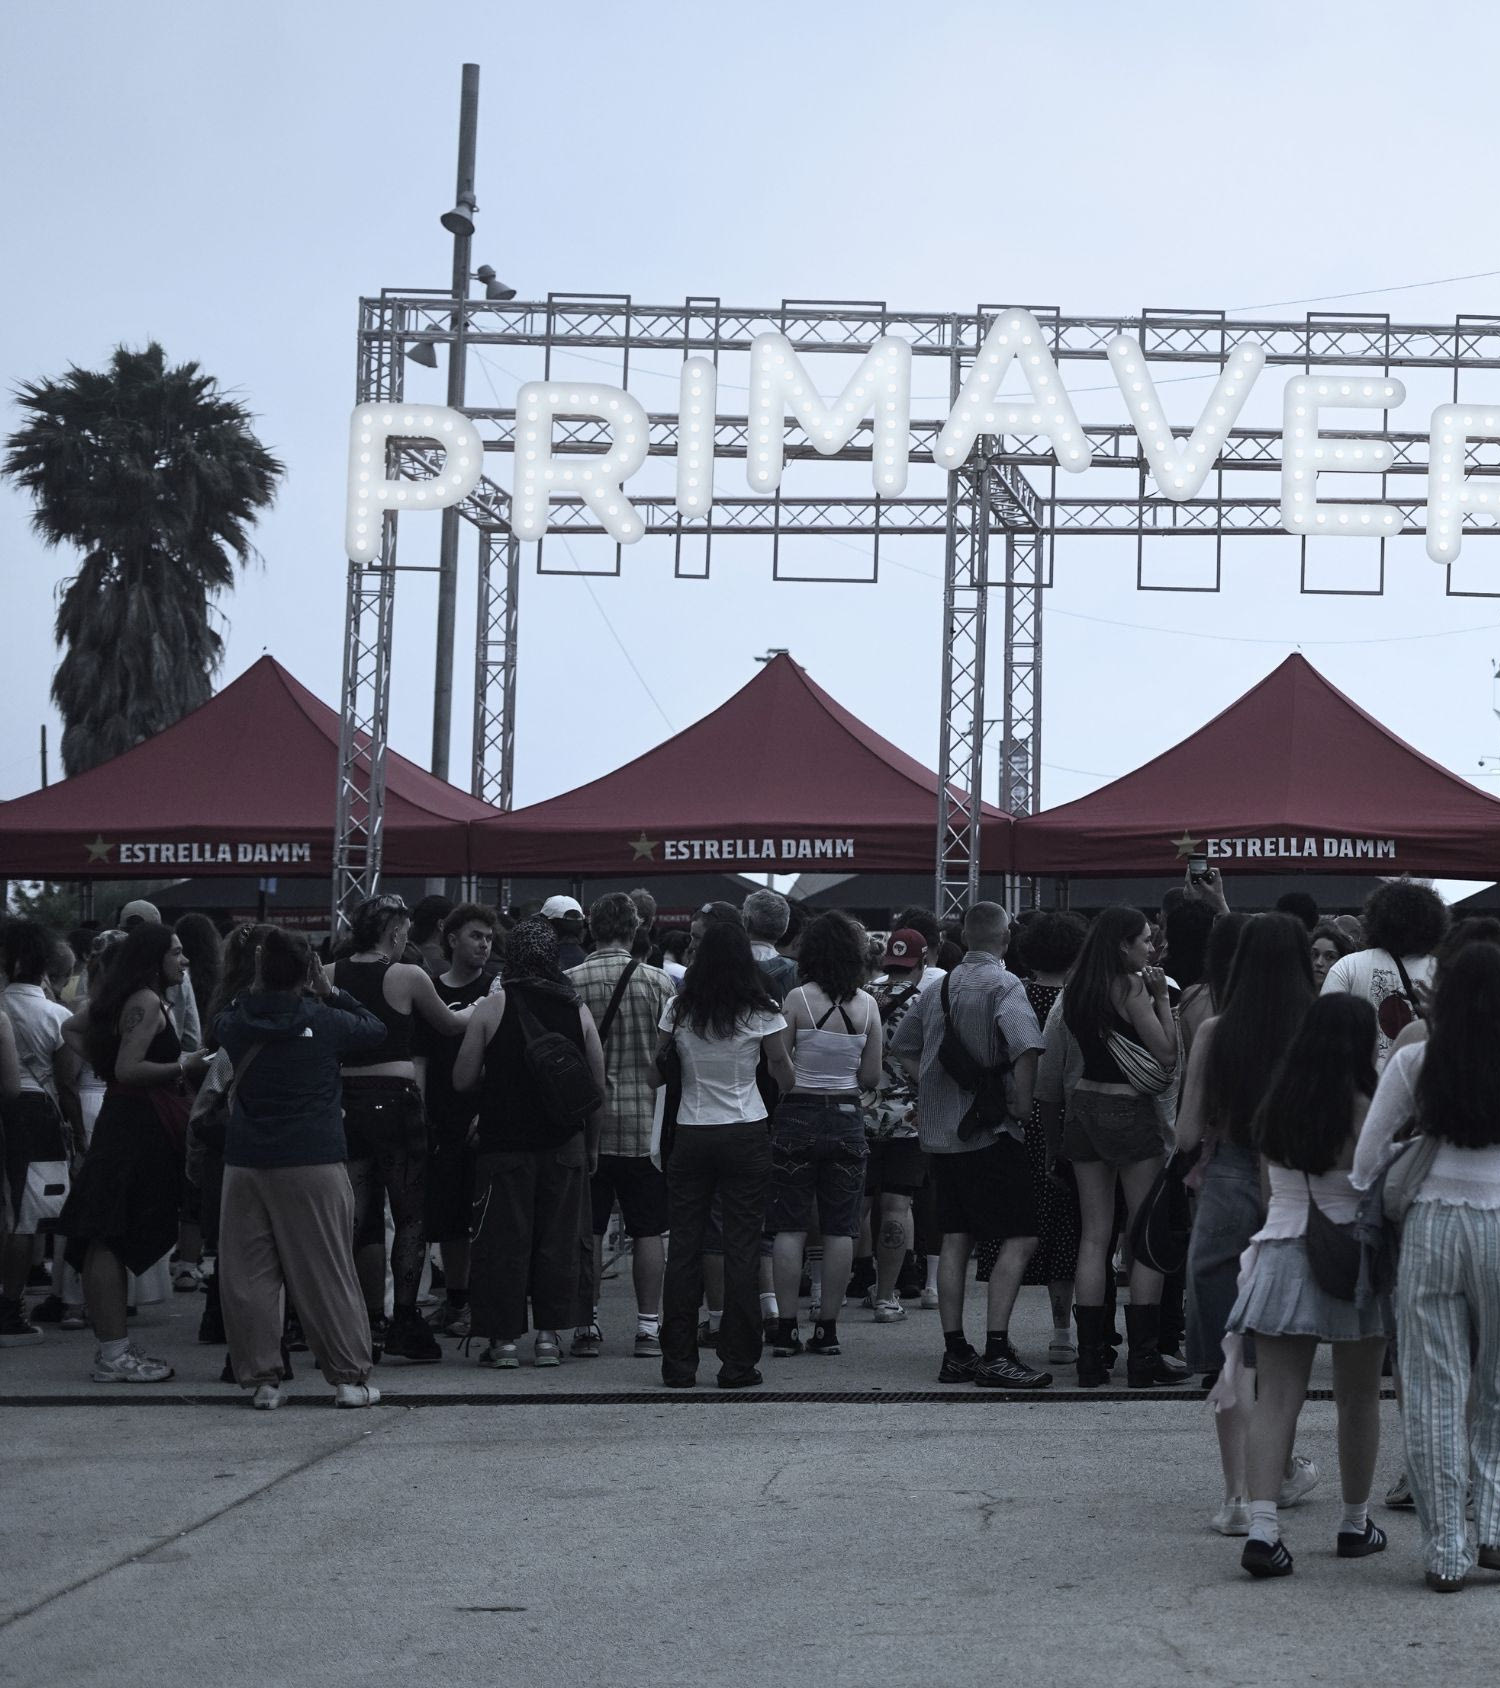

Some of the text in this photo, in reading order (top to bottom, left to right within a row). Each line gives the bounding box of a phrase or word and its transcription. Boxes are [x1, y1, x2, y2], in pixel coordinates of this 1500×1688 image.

[119, 843, 311, 863] ESTRELLA DAMM
[664, 838, 855, 860] ESTRELLA DAMM
[1207, 837, 1396, 858] ESTRELLA DAMM
